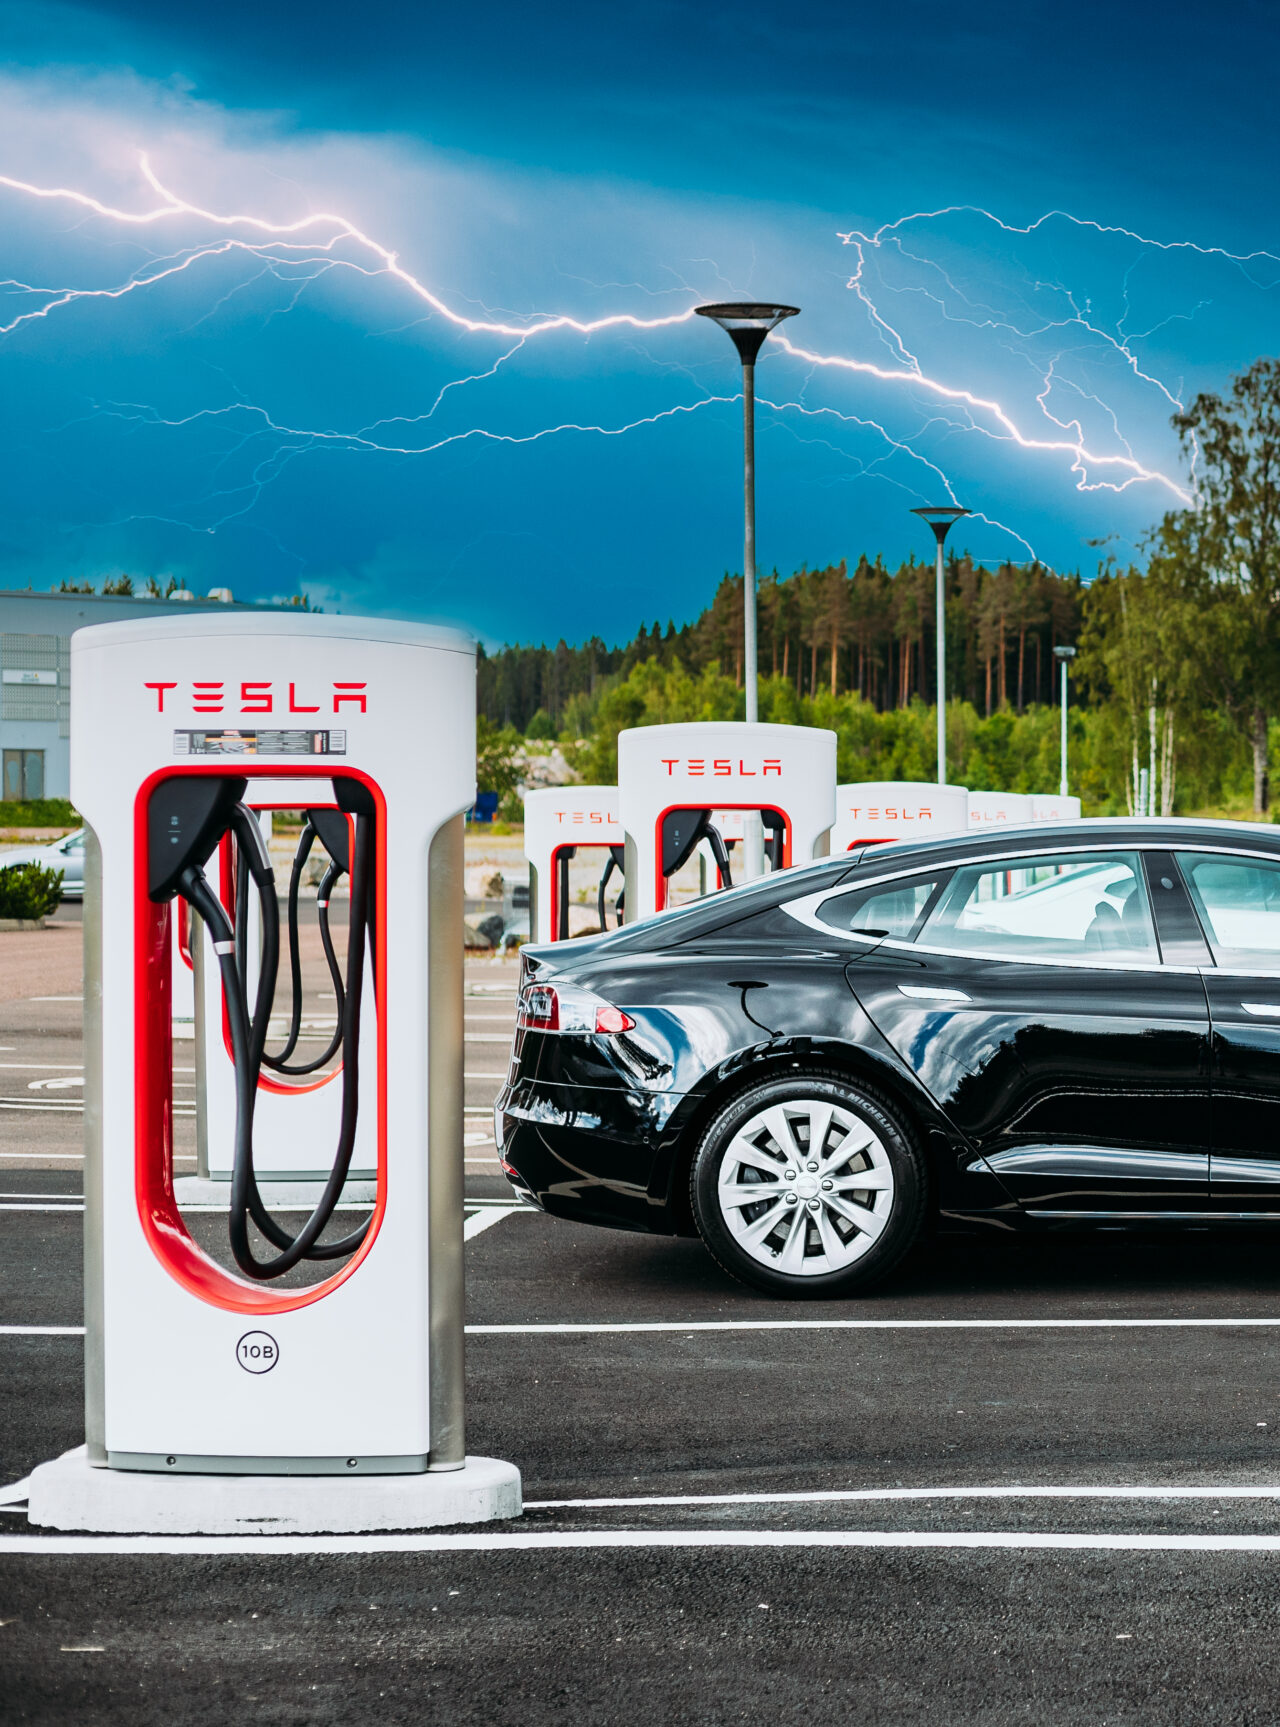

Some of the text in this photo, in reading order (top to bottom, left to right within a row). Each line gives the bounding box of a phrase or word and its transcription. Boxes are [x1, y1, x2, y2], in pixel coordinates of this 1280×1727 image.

[143, 682, 367, 713] TESLA
[661, 759, 782, 776] TESLA
[553, 812, 619, 824] TESL
[850, 807, 932, 820] TESLA
[970, 811, 1007, 821] SLA
[846, 1092, 897, 1137] MICHELIN
[242, 1345, 274, 1359] 10B
